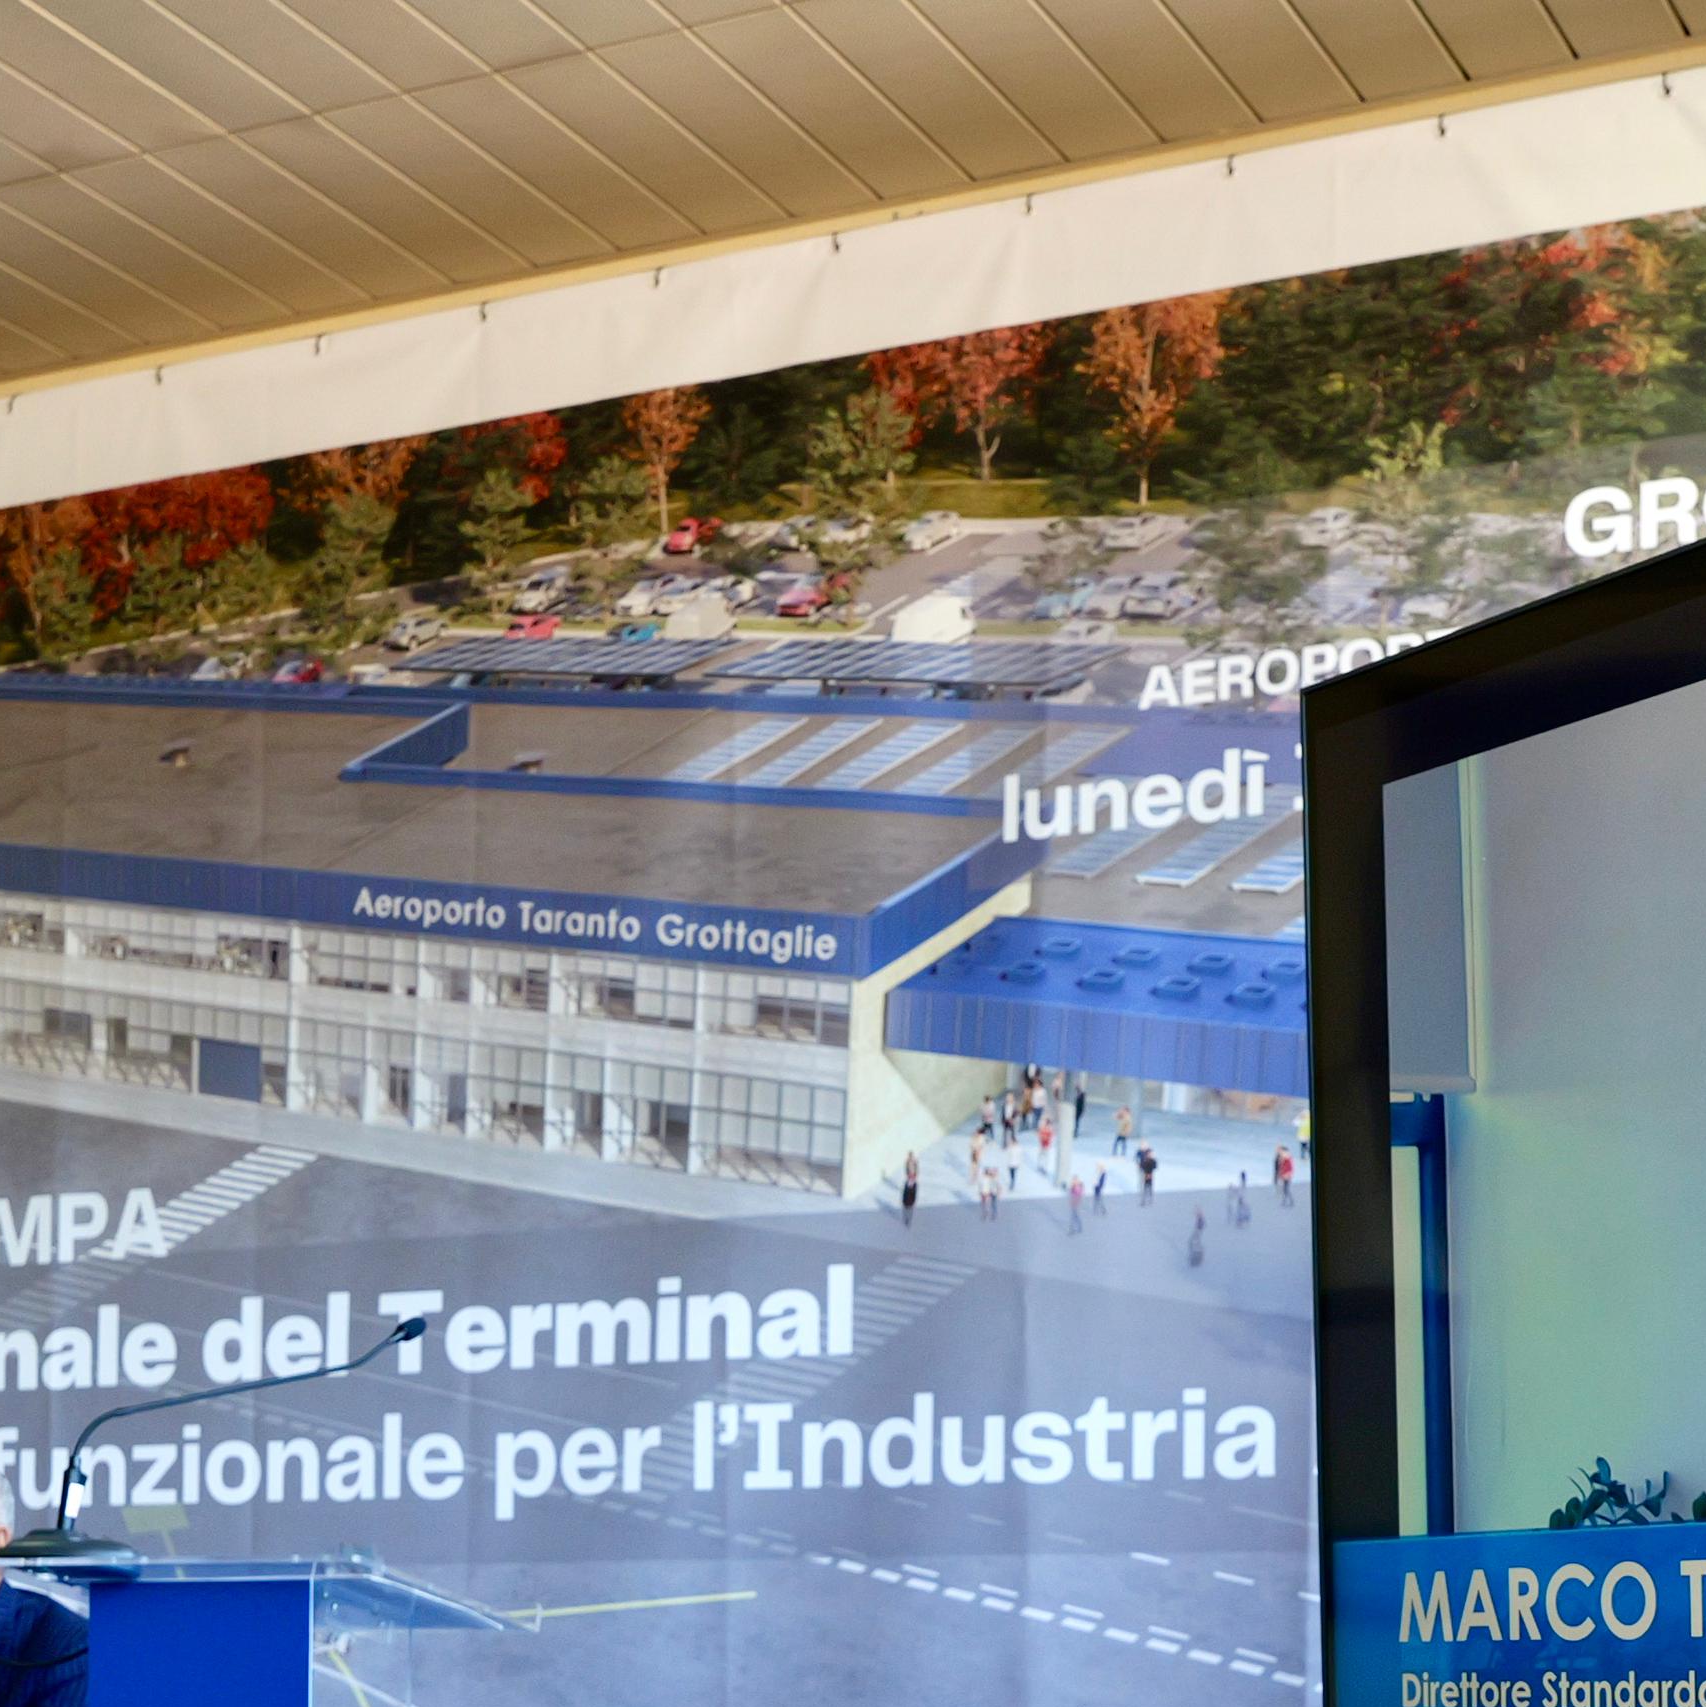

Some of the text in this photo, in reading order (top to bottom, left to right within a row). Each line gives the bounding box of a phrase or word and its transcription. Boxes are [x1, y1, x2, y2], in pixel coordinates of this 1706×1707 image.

[1138, 626, 1461, 711] AEROPO
[1002, 747, 1271, 844] lunedì
[353, 886, 838, 964] Aeroporto Taranto Grottaglie
[201, 1291, 351, 1382] del
[378, 1263, 855, 1375] Terminal
[494, 1423, 661, 1521] per
[1398, 1560, 1656, 1643] MARCO
